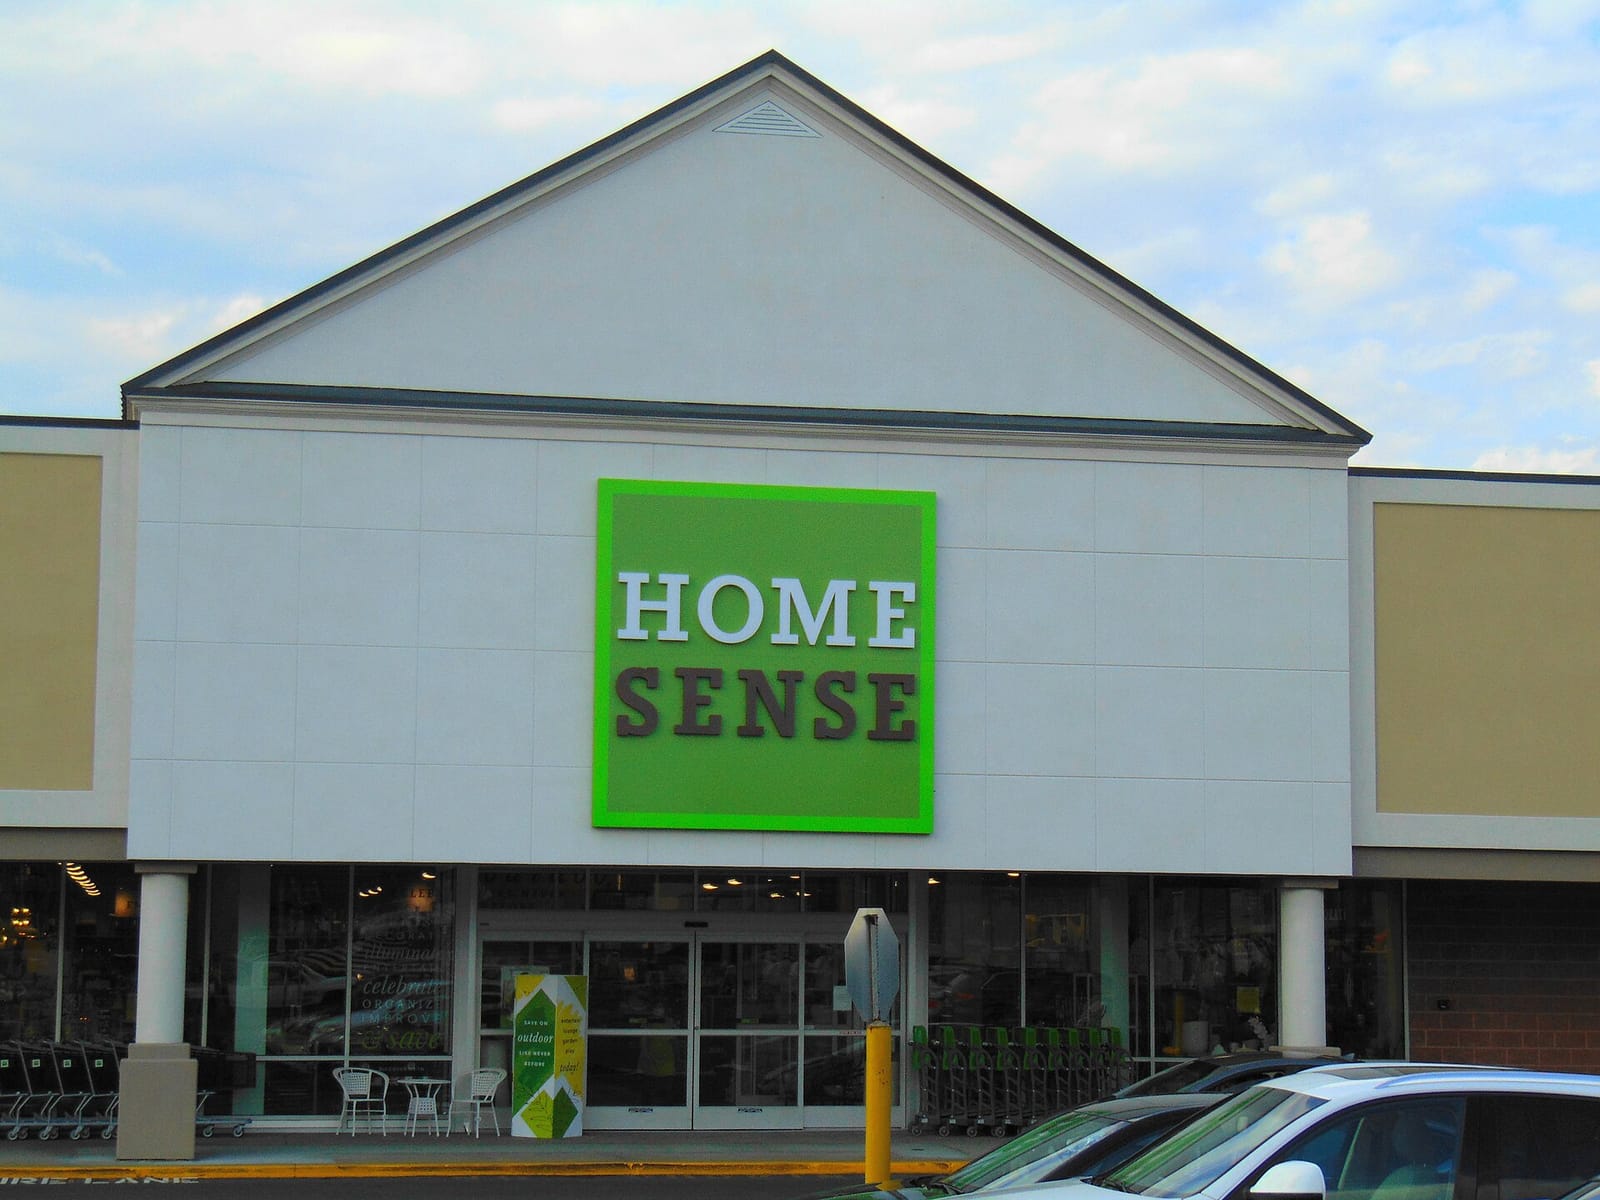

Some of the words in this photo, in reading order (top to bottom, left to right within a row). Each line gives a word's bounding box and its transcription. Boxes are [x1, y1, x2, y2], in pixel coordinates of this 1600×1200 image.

[617, 571, 916, 649] HOME
[615, 666, 916, 741] SENSE
[362, 975, 441, 995] celebrate
[385, 1029, 441, 1050] save
[517, 1031, 554, 1043] outdoor
[84, 1176, 200, 1185] LANE
